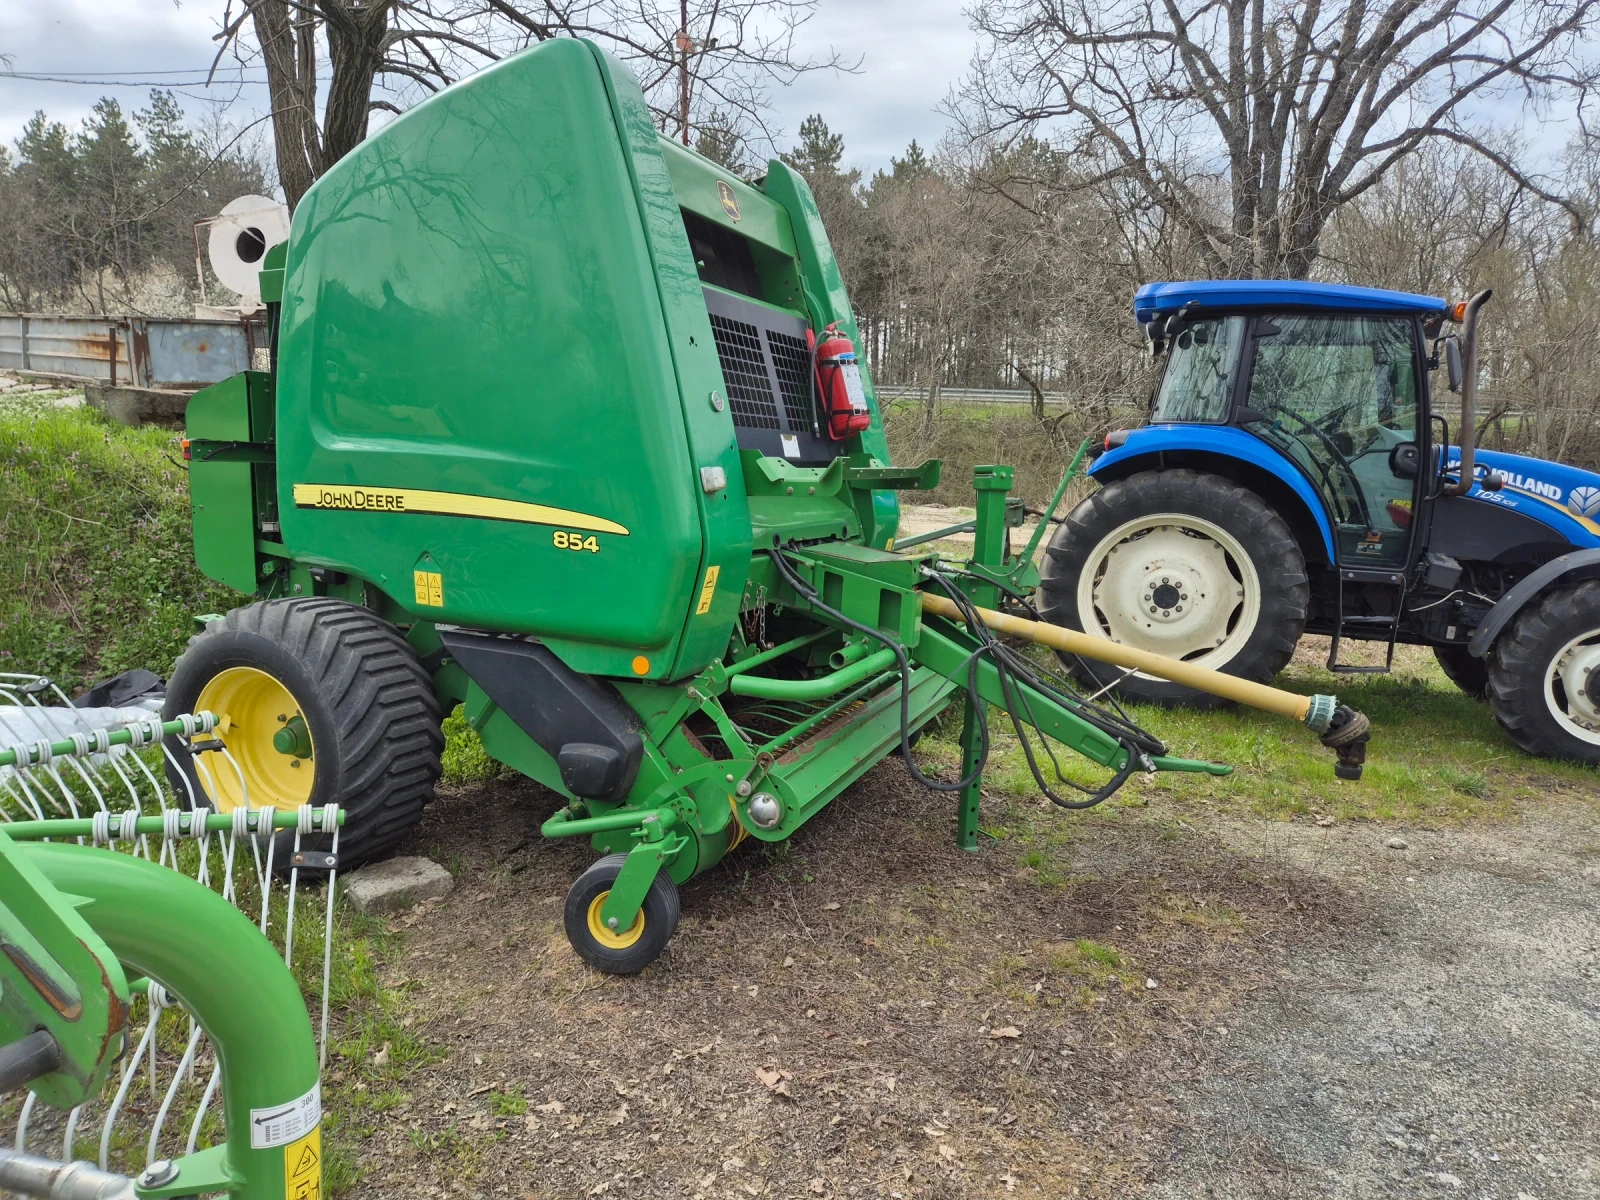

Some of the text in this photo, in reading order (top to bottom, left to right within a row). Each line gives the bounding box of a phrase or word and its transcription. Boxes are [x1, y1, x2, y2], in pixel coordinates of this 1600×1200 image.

[316, 489, 405, 510] JOHN DEERE
[553, 530, 600, 554] 854
[301, 1094, 314, 1108] 300
